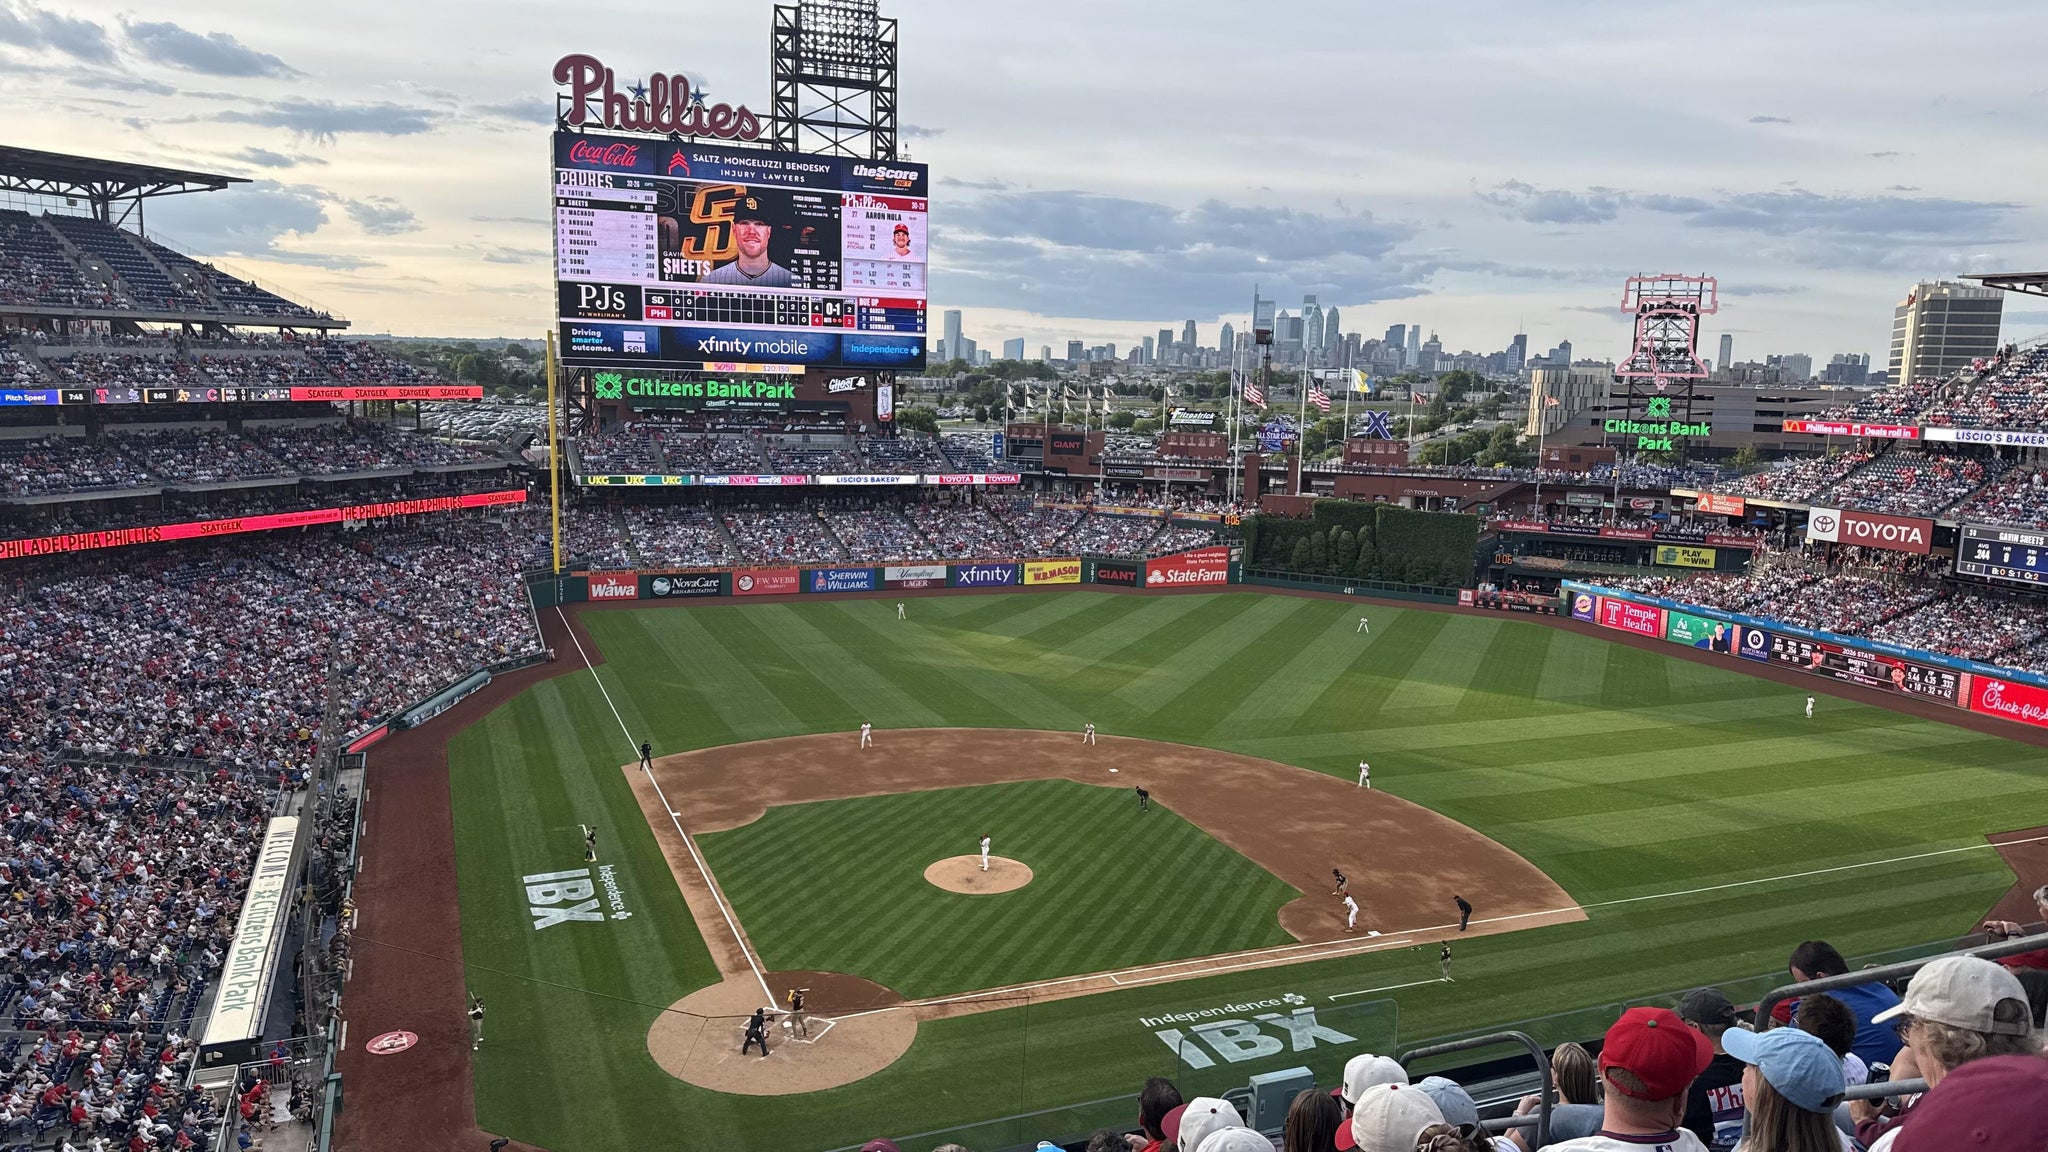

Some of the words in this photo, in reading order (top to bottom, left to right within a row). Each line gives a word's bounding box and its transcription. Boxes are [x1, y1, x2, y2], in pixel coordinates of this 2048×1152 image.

[552, 54, 761, 140] Phillies
[693, 154, 720, 163] SALTZ
[724, 157, 782, 169] MONGELUZZI
[785, 162, 831, 173] BENDESKY
[721, 169, 755, 178] INJURY
[763, 173, 805, 182] LAWYERS
[853, 165, 918, 181] theScore
[560, 172, 613, 188] PADRES
[842, 193, 888, 209] Phillies
[568, 209, 595, 217] MACHADO
[866, 212, 886, 220] AARON
[887, 213, 902, 221] NOLA
[569, 219, 593, 227] ANDUJAR
[569, 229, 592, 237] MERRILL
[569, 239, 597, 247] BOGAERTS
[663, 258, 711, 276] SHEETS
[652, 296, 664, 304] SD
[859, 298, 870, 306] DUE
[651, 309, 666, 318] PHI
[826, 303, 841, 315] 0-1
[572, 329, 601, 337] Driving
[698, 336, 751, 355] xfinity
[755, 339, 808, 355] mobile
[851, 344, 909, 355] Independence
[626, 378, 703, 398] Citizens
[707, 380, 753, 398] Bank
[755, 382, 796, 399] Park
[828, 377, 859, 394] GHOST
[24, 394, 46, 402] Speed
[308, 388, 343, 398] SEATGEEK
[355, 388, 388, 398] SEATGEEK
[399, 388, 430, 398] SEATGEEK
[440, 388, 470, 397] SEATGEEK
[1173, 407, 1215, 420] Fitzpatrick
[1604, 419, 1667, 435] Citizens
[1670, 422, 1711, 437] Bank
[1805, 423, 1832, 434] Phillies
[1834, 426, 1847, 434] win
[1865, 427, 1886, 436] Deals
[1888, 427, 1902, 437] roll
[1281, 432, 1295, 440] GAME
[1956, 431, 2003, 442] LISCIO'S
[1053, 441, 1080, 449] GIANT
[1638, 437, 1672, 451] Park
[588, 476, 609, 484] UKG
[625, 476, 646, 484] UKG
[661, 476, 682, 485] UKG
[733, 476, 754, 484] NECA
[784, 476, 806, 484] NECA
[340, 507, 358, 521] THE
[360, 499, 425, 519] PHILADELPHIA
[427, 495, 463, 511] PHILLIES
[488, 493, 516, 503] SEATGEEK
[105, 526, 161, 549] PHILLIES
[200, 520, 243, 534] SEATGEEK
[1615, 530, 1647, 538] Budweiser
[1844, 519, 1923, 545] TOYOTA
[1722, 538, 1755, 546] Budweiser
[1999, 532, 2019, 542] GAVIN
[2019, 534, 2044, 546] SHEETS
[1682, 549, 1702, 557] PLAY
[1974, 549, 1990, 560] .244
[829, 571, 868, 580] SHERWIN
[896, 569, 935, 578] Yuengling
[960, 566, 1011, 584] xfinity
[1098, 569, 1137, 581] GIANT
[1992, 567, 1999, 575] B:
[2000, 568, 2006, 576] 0
[672, 577, 719, 588] NovaCare
[591, 584, 635, 597] Wawa
[1344, 587, 1355, 595] 401
[1624, 605, 1657, 620] Temple
[1622, 617, 1653, 633] Health
[1783, 626, 1809, 635] Independence
[1742, 647, 1768, 656] ROTHMAN
[1871, 643, 1901, 653] Independence
[1842, 648, 1857, 657] 2026
[1857, 650, 1876, 661] STATS
[1848, 658, 1868, 668] SHEETS
[1849, 666, 1865, 675] NOLA
[1972, 664, 2005, 675] Independence
[1907, 672, 1920, 681] 5.46
[1924, 675, 1937, 685] 4.35
[1941, 680, 1954, 689] .332
[258, 830, 294, 880] WELCOME
[598, 864, 625, 911] Independence
[522, 868, 604, 930] IBX
[240, 900, 278, 945] Citizens
[234, 945, 266, 978] Bank
[221, 981, 259, 1014] Park
[1139, 997, 1281, 1027] Independence
[1155, 1006, 1358, 1069] IBX
